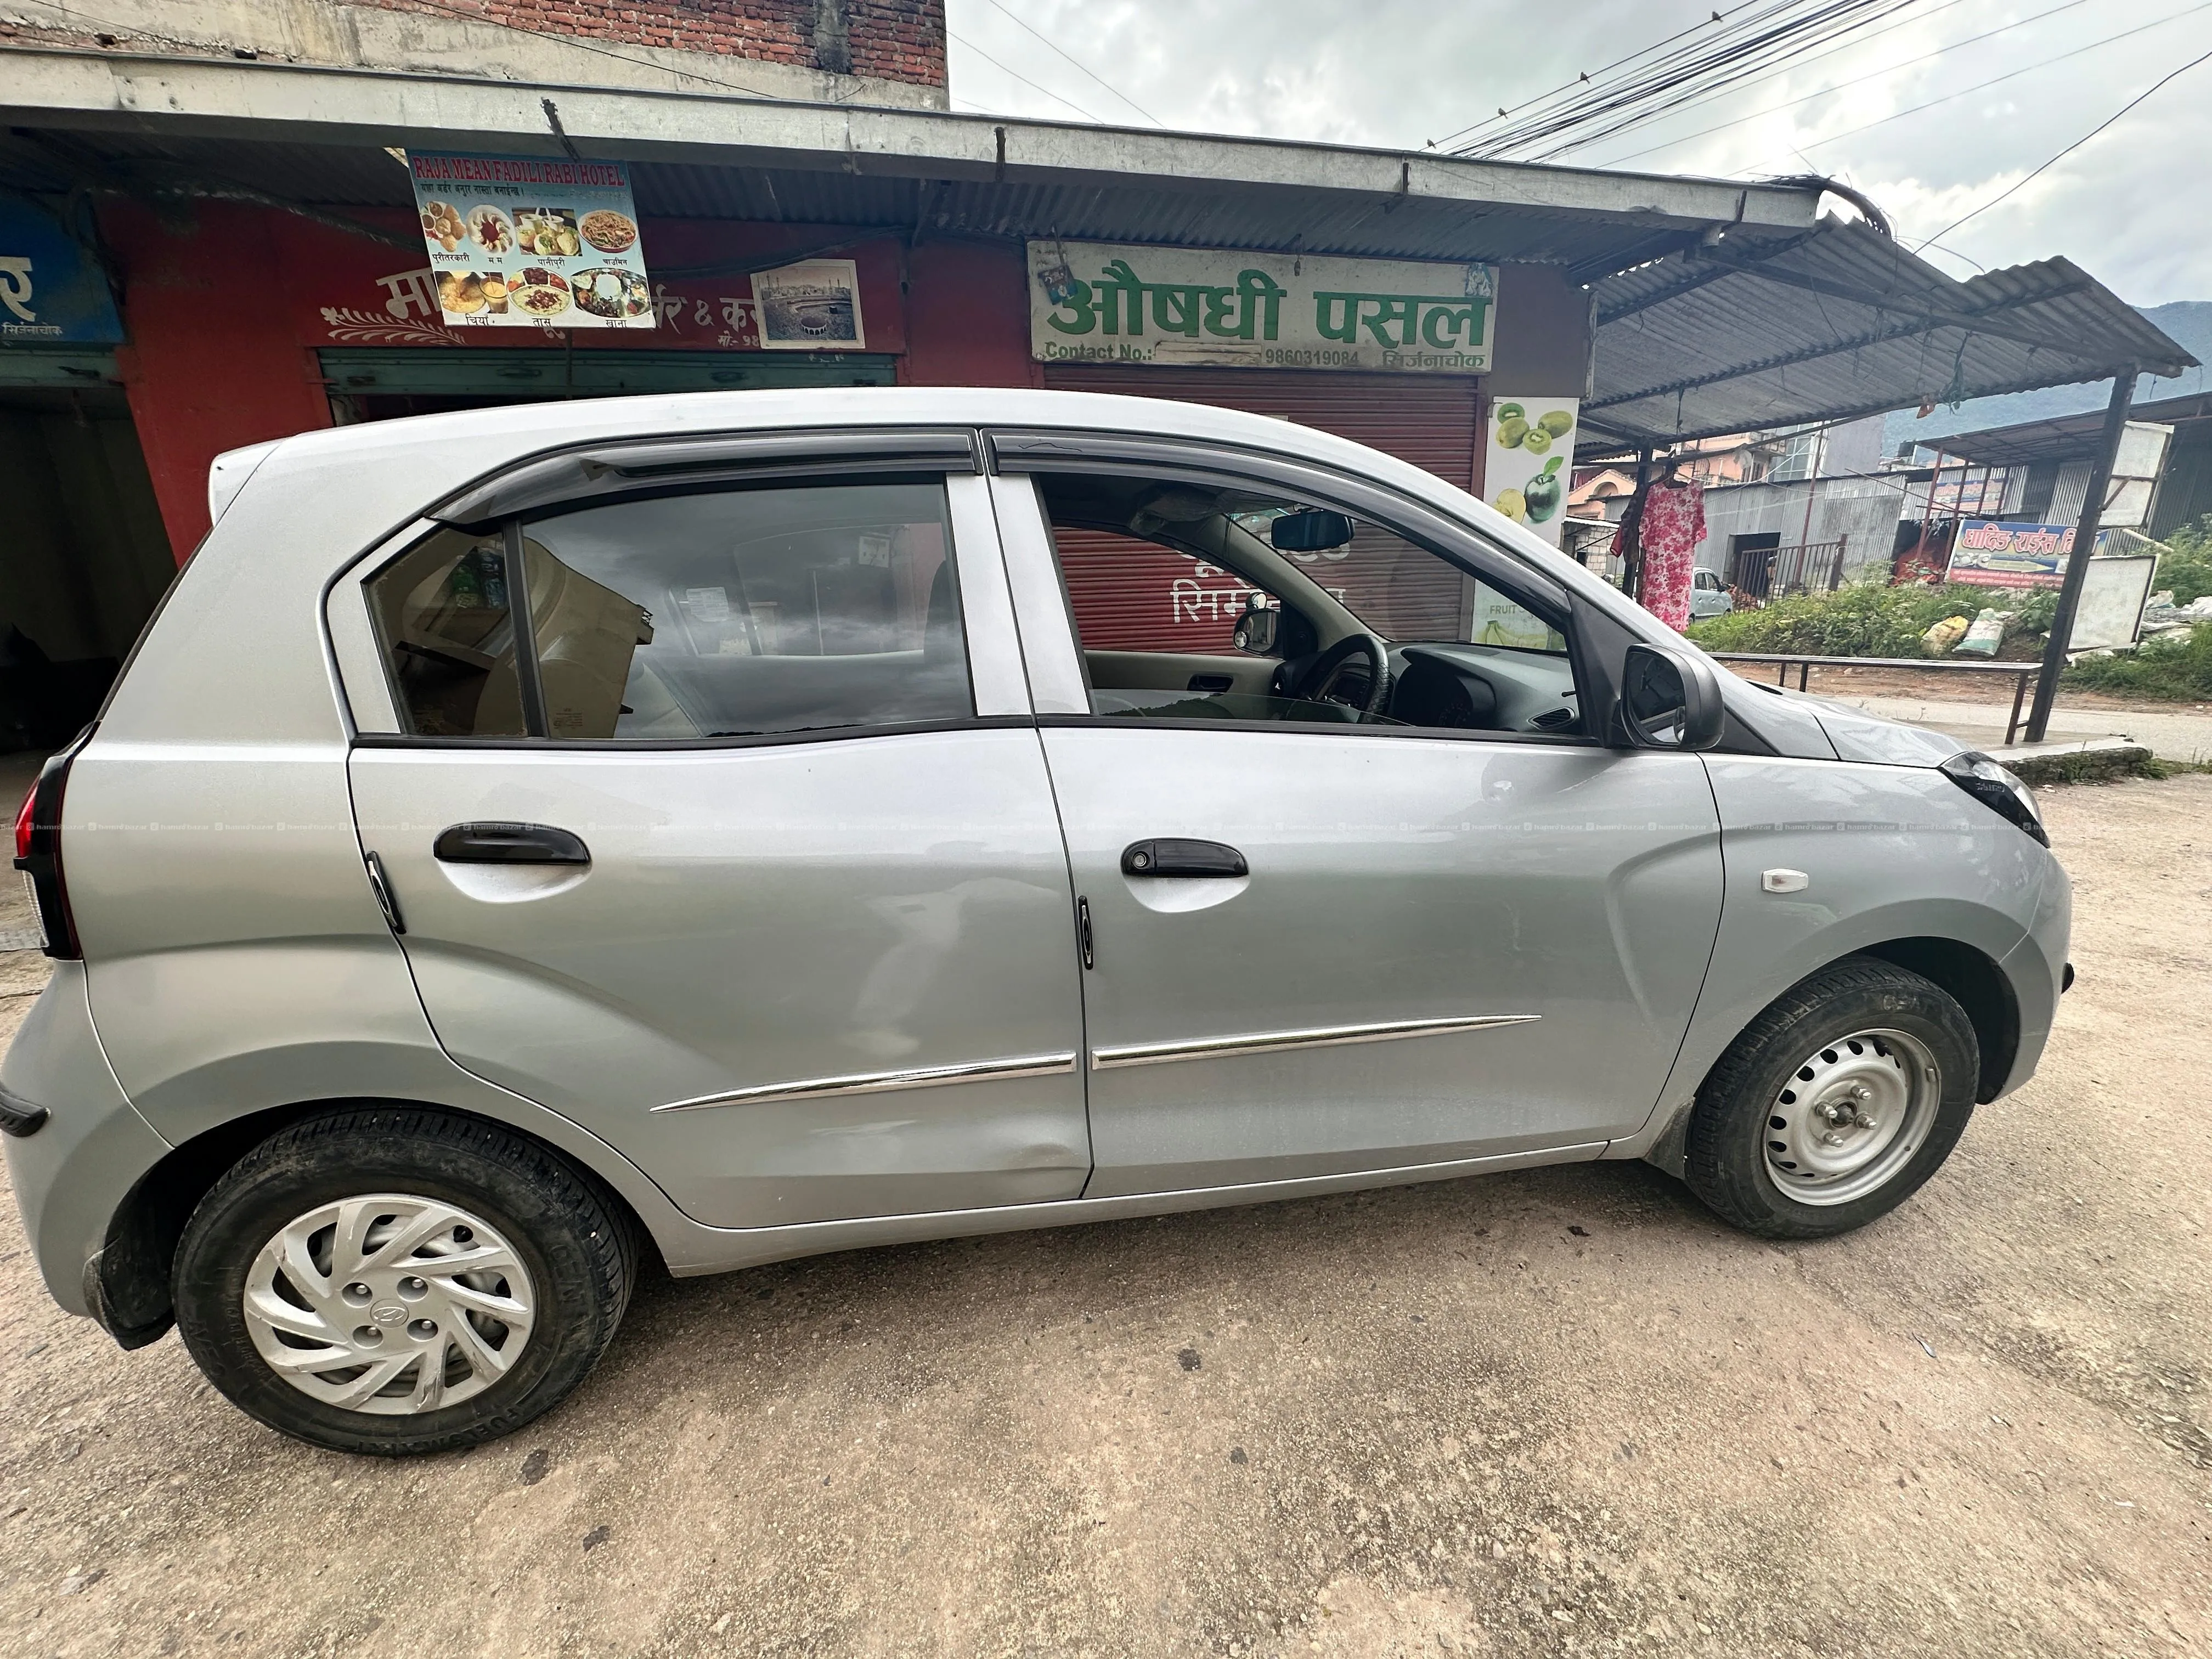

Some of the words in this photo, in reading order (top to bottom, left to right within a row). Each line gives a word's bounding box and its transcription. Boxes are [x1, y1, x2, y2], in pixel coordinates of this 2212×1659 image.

[412, 157, 451, 179] RAJA
[450, 159, 492, 182] MEAN
[493, 160, 543, 184] FADILI
[545, 163, 578, 185] RABI
[580, 165, 625, 187] HOTEL
[432, 252, 470, 264] पुरीतरकारी
[538, 257, 565, 269] पानीपुरी
[694, 300, 715, 326] &
[1047, 259, 1287, 340] औषधी
[1313, 291, 1493, 349] पसल
[1045, 341, 1114, 359] Contact
[1265, 348, 1359, 366] 9860319084
[1381, 350, 1486, 368] सिर्जनाचोक
